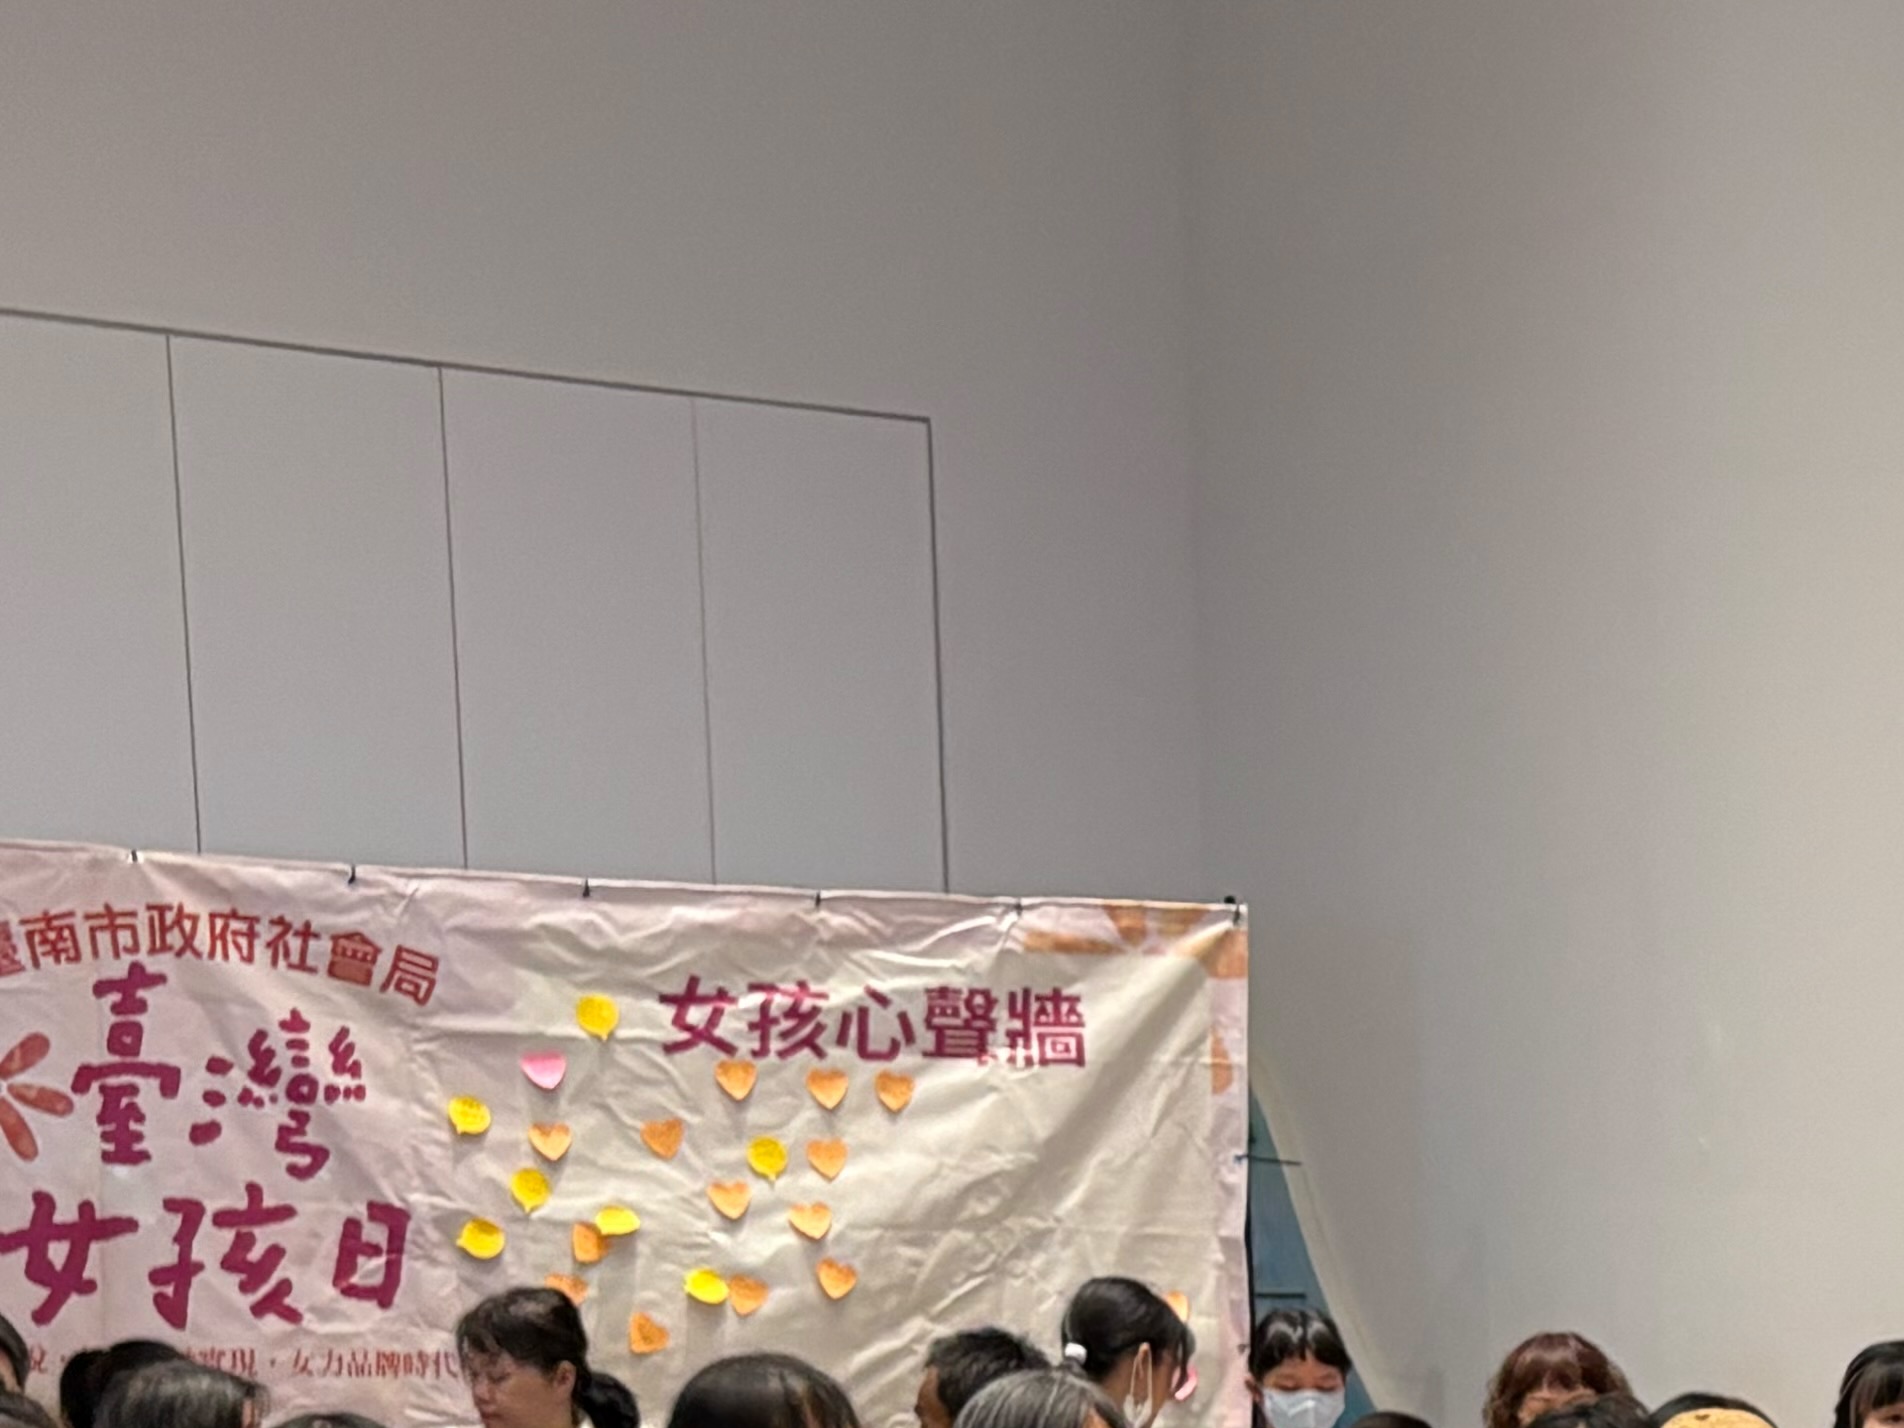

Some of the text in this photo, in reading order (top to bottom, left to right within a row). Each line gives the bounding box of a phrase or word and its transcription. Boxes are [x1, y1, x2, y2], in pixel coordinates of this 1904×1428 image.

[71, 961, 366, 1180] 臺灣
[659, 975, 1086, 1068] 女孩心聲牆
[0, 1182, 411, 1330] 女孩日
